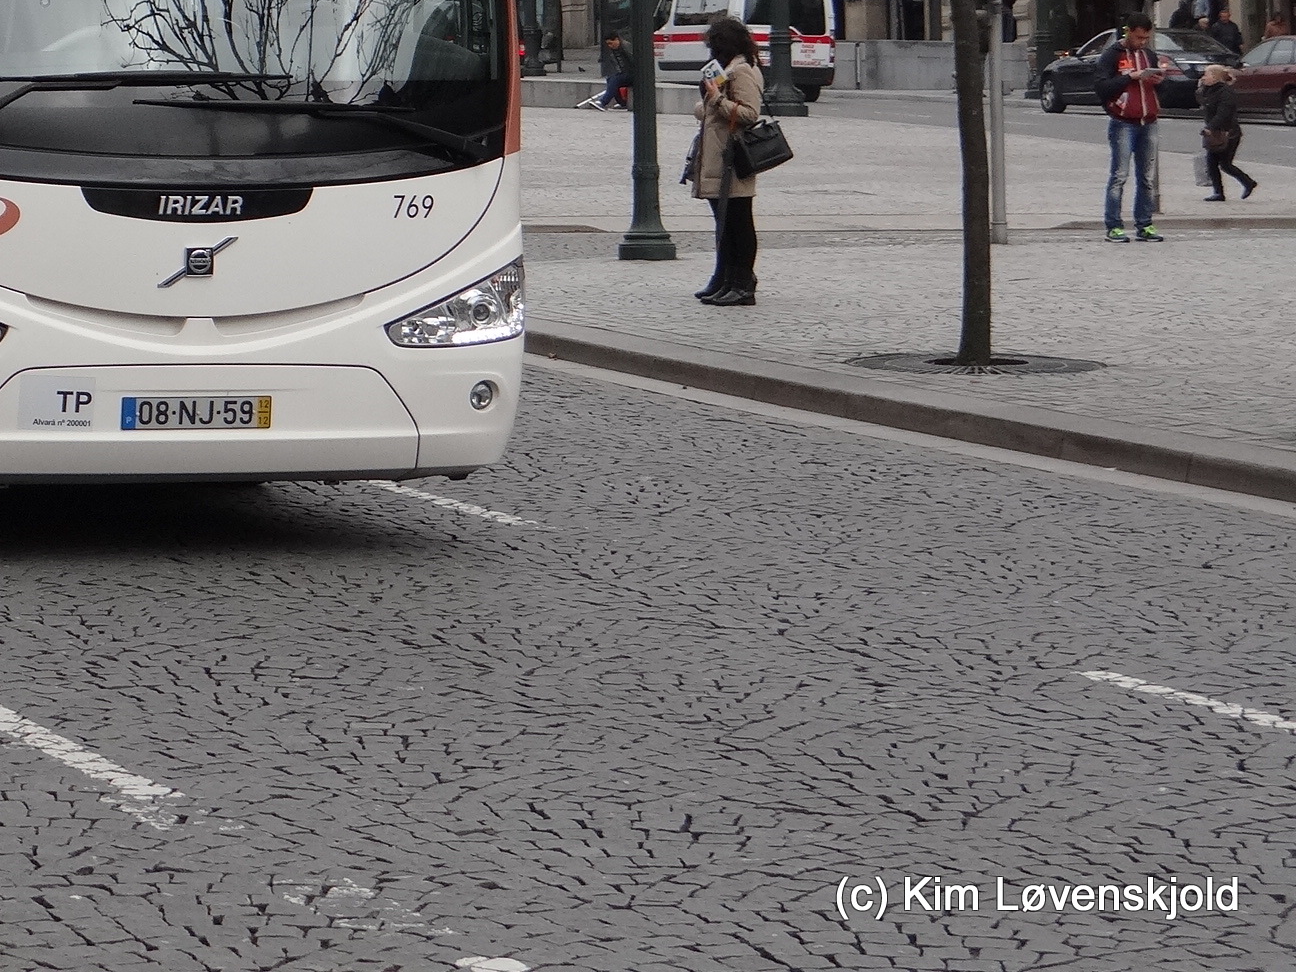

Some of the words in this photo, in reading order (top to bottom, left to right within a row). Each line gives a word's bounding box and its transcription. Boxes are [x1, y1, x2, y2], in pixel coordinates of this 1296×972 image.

[158, 195, 244, 216] IRIZAR
[393, 195, 435, 219] 769
[57, 391, 92, 413] TP
